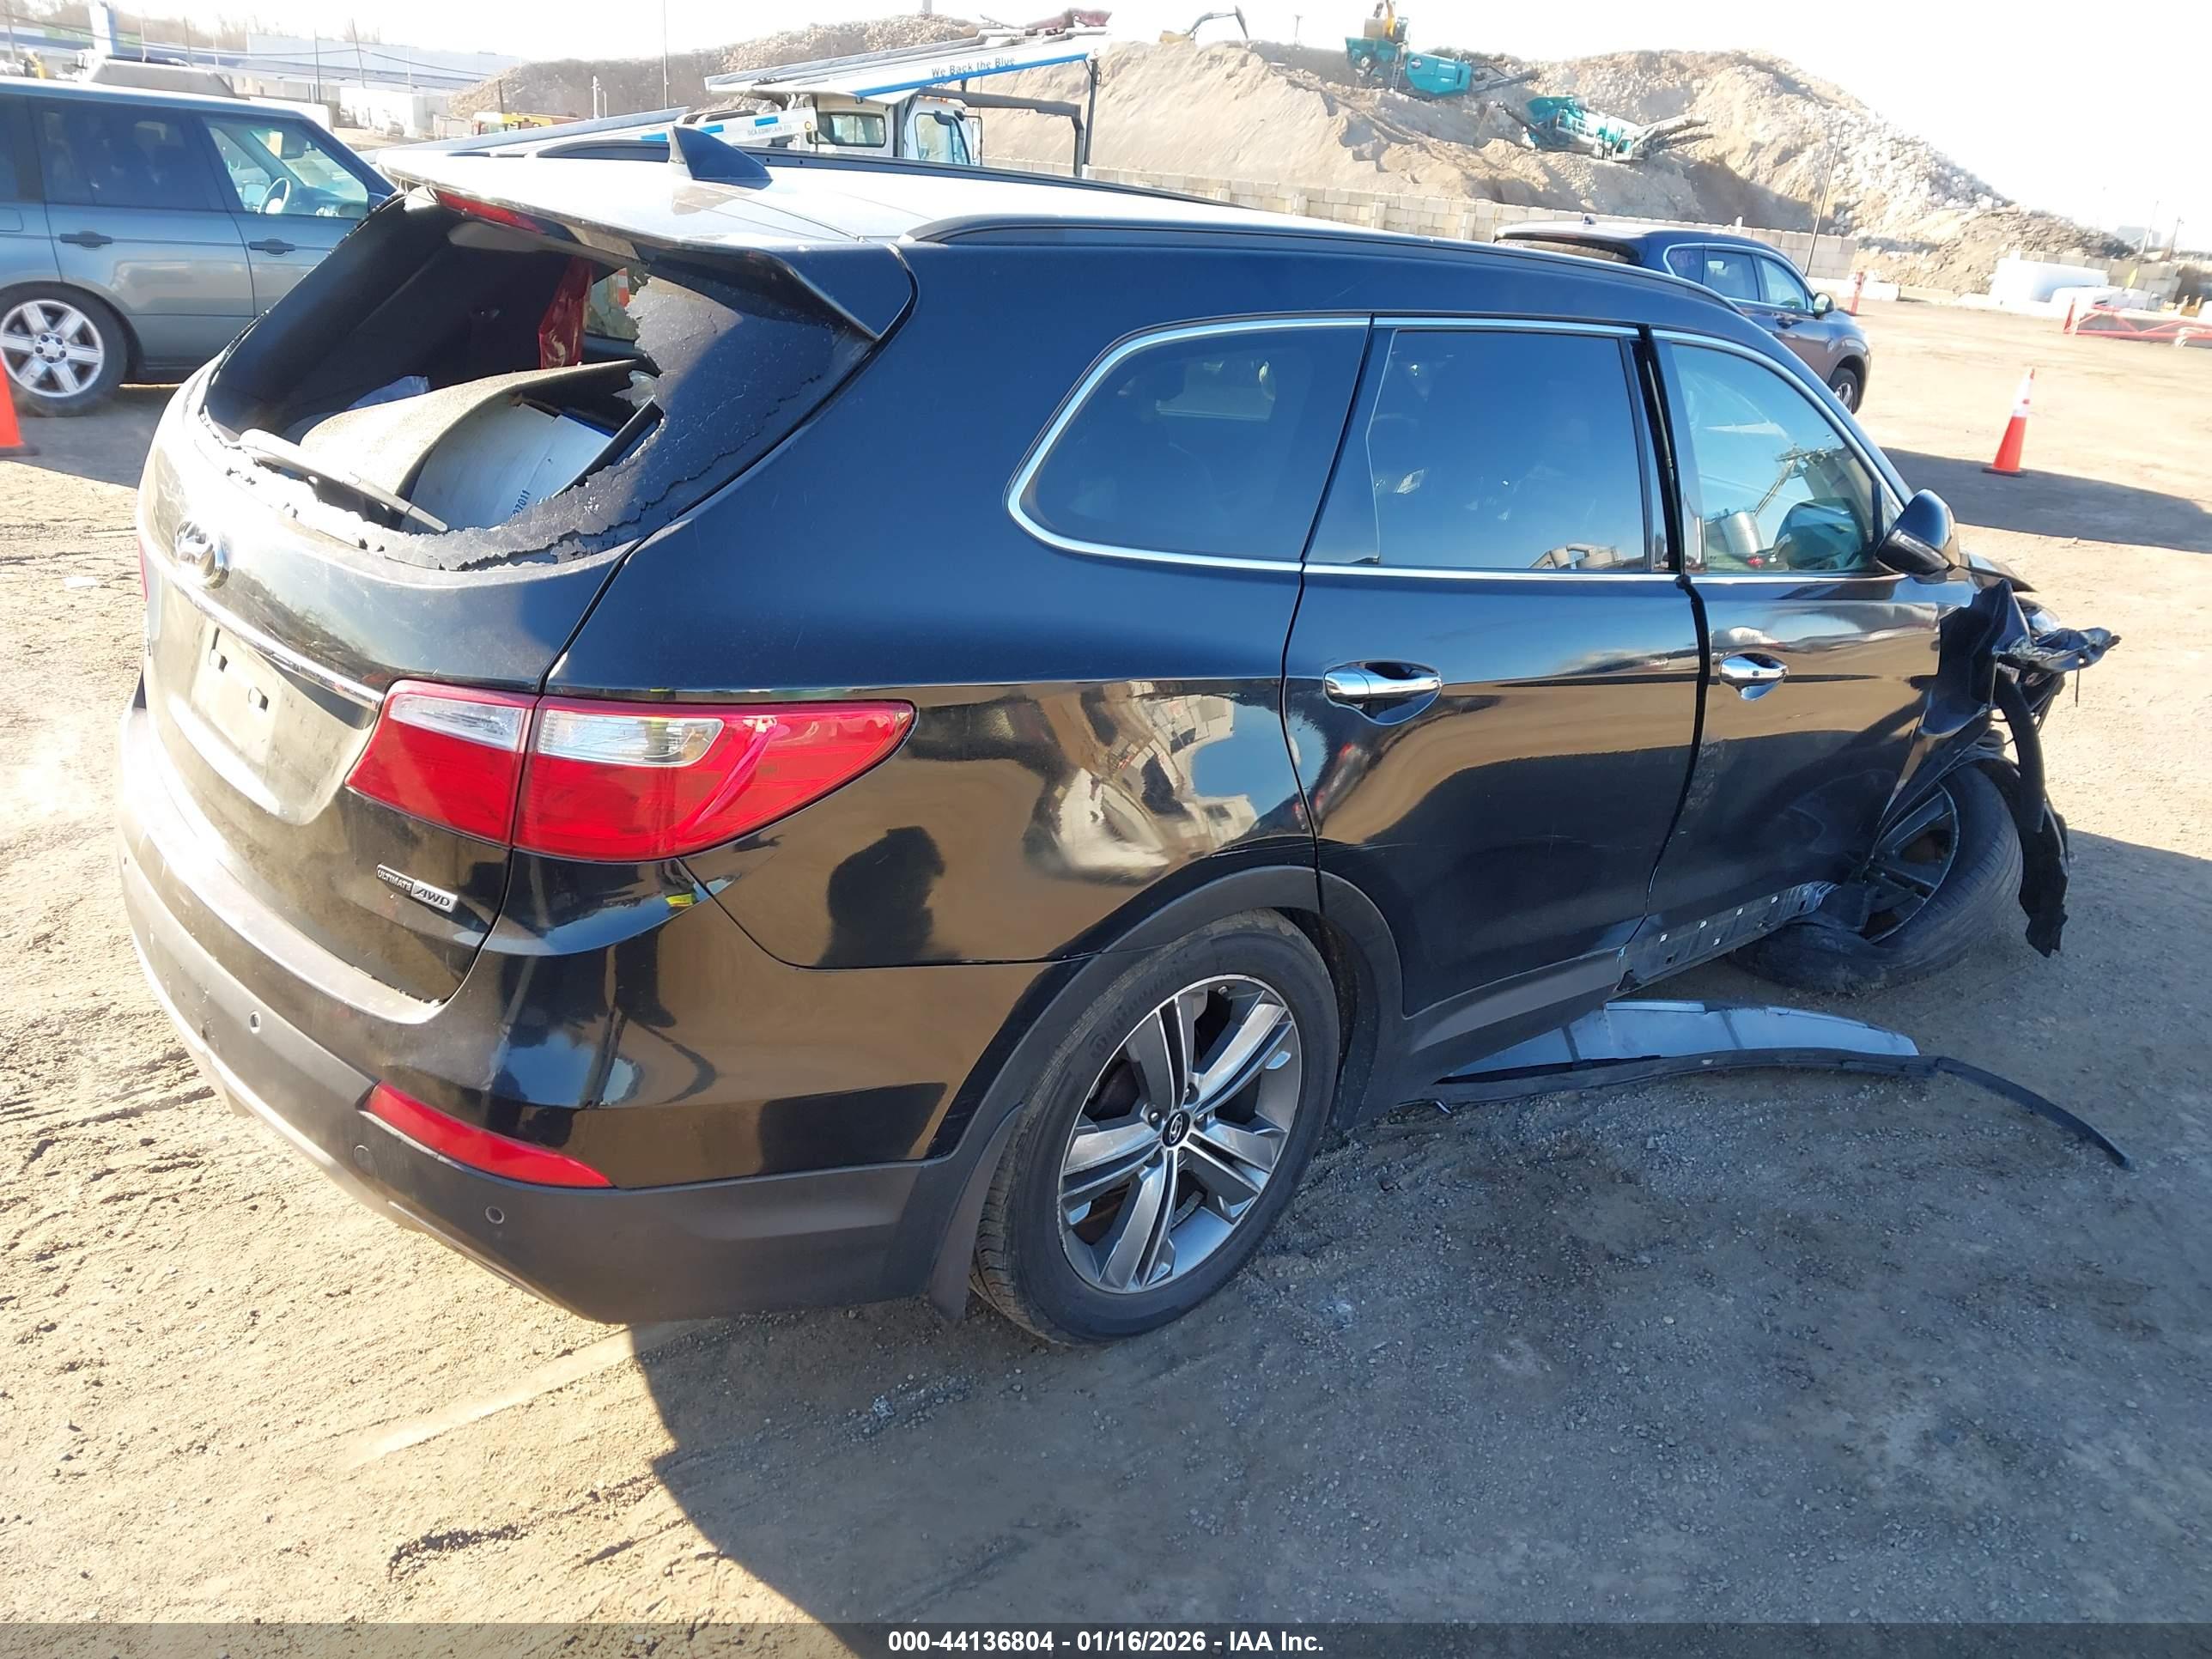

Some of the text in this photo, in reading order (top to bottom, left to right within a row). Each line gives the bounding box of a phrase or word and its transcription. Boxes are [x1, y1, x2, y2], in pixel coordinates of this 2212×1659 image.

[932, 57, 1016, 77] We Back the Blue
[378, 868, 451, 907] ULTIMATE AWD
